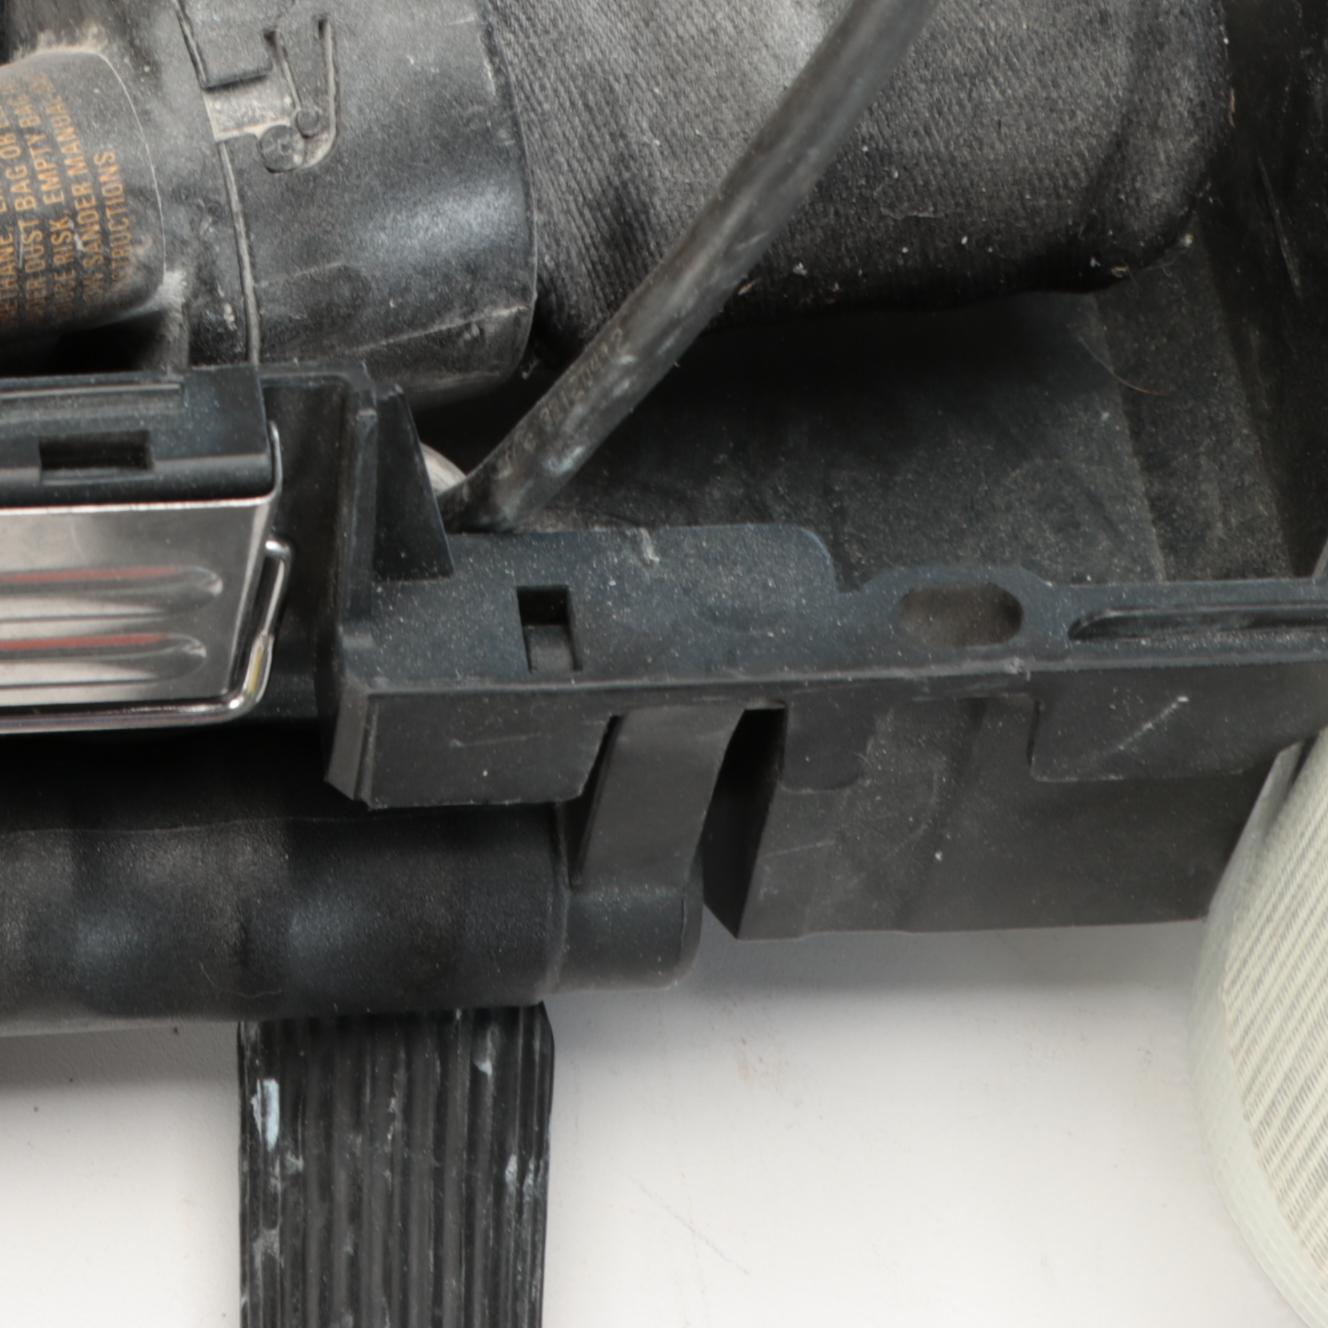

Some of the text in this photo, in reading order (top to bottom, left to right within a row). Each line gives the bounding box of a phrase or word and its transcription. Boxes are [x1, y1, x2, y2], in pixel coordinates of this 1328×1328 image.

[4, 165, 38, 214] BAG
[25, 132, 65, 207] EMPTY
[18, 219, 48, 274] DUST
[72, 180, 104, 269] SANDER
